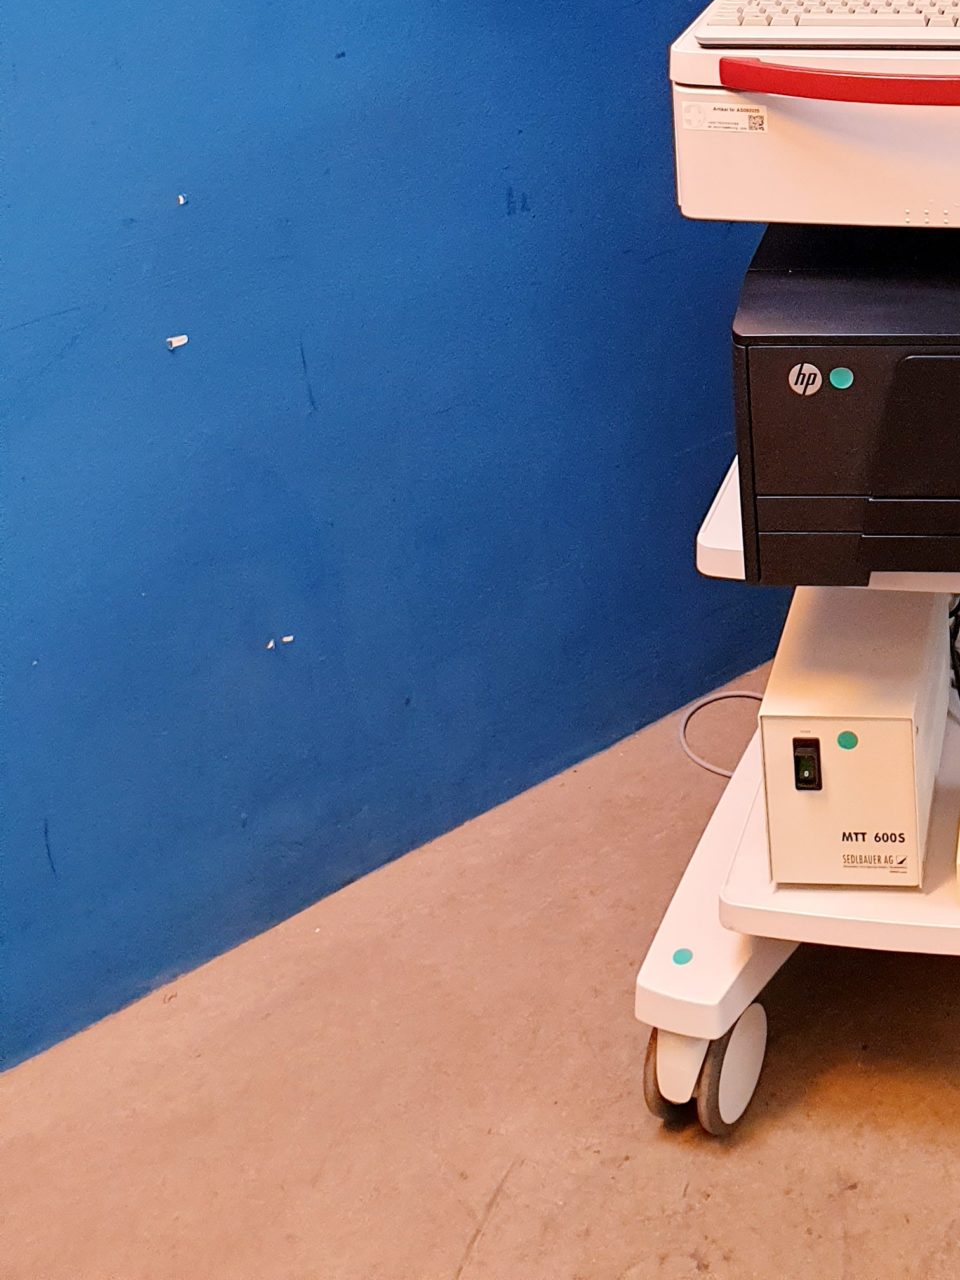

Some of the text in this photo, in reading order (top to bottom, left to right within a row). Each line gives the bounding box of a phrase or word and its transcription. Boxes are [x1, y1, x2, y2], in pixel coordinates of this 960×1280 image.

[794, 363, 817, 395] hp
[842, 832, 906, 843] MTT 600S
[842, 854, 894, 864] SEDLBAUER AG
